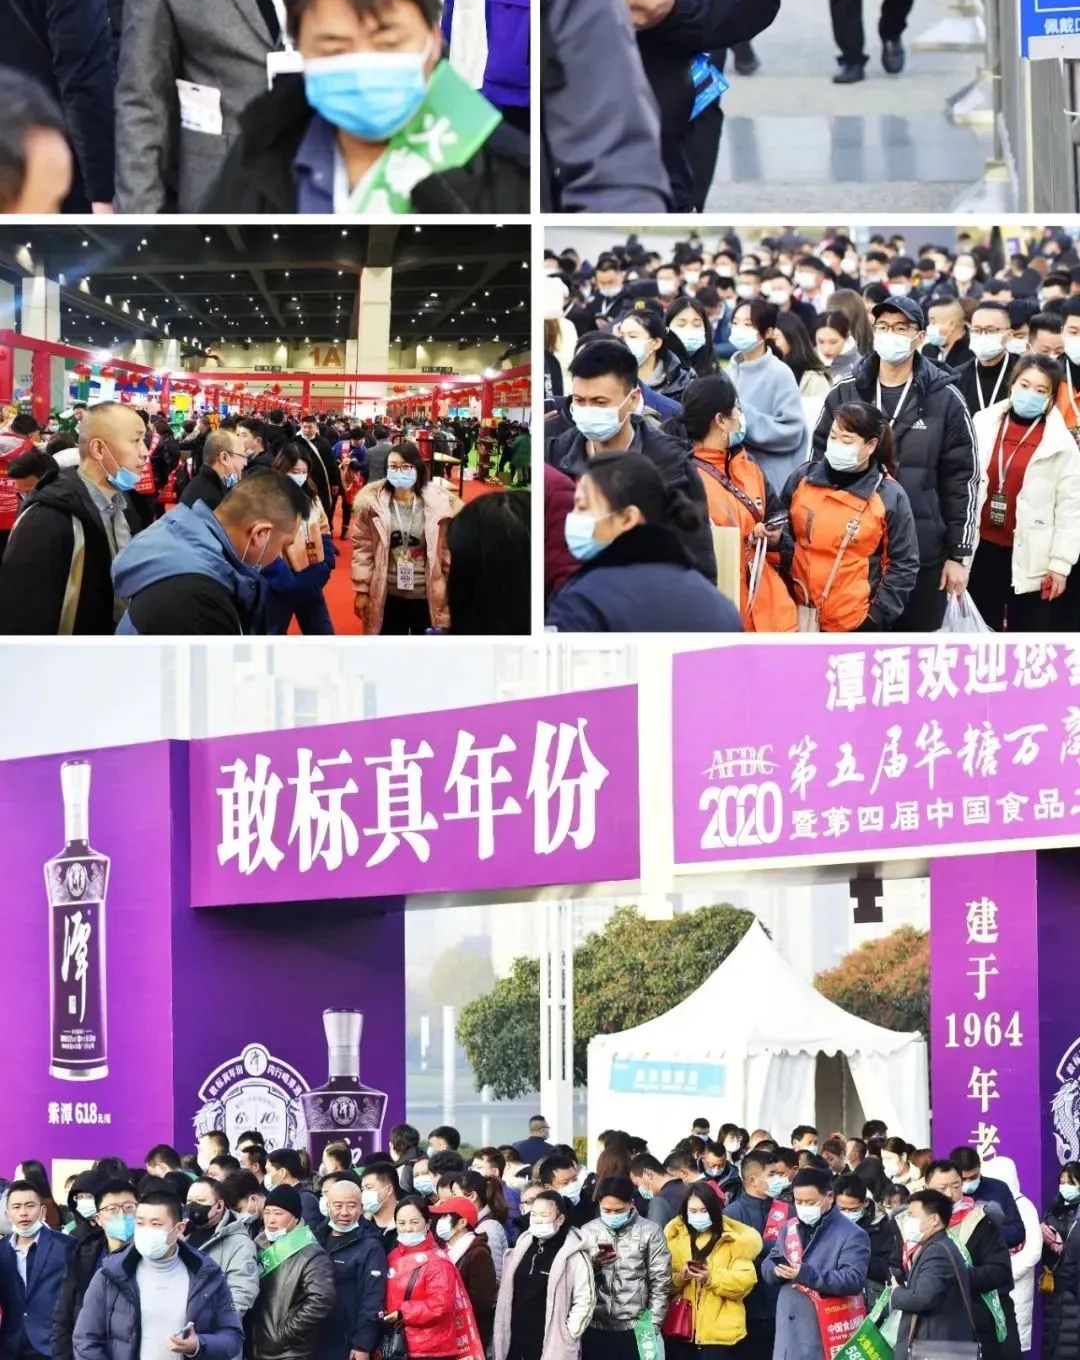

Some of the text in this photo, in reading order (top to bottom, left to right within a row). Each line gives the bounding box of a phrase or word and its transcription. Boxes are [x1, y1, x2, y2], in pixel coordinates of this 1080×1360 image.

[309, 347, 341, 366] 1A
[216, 717, 610, 876] 敢标真年份
[699, 781, 783, 850] 2020
